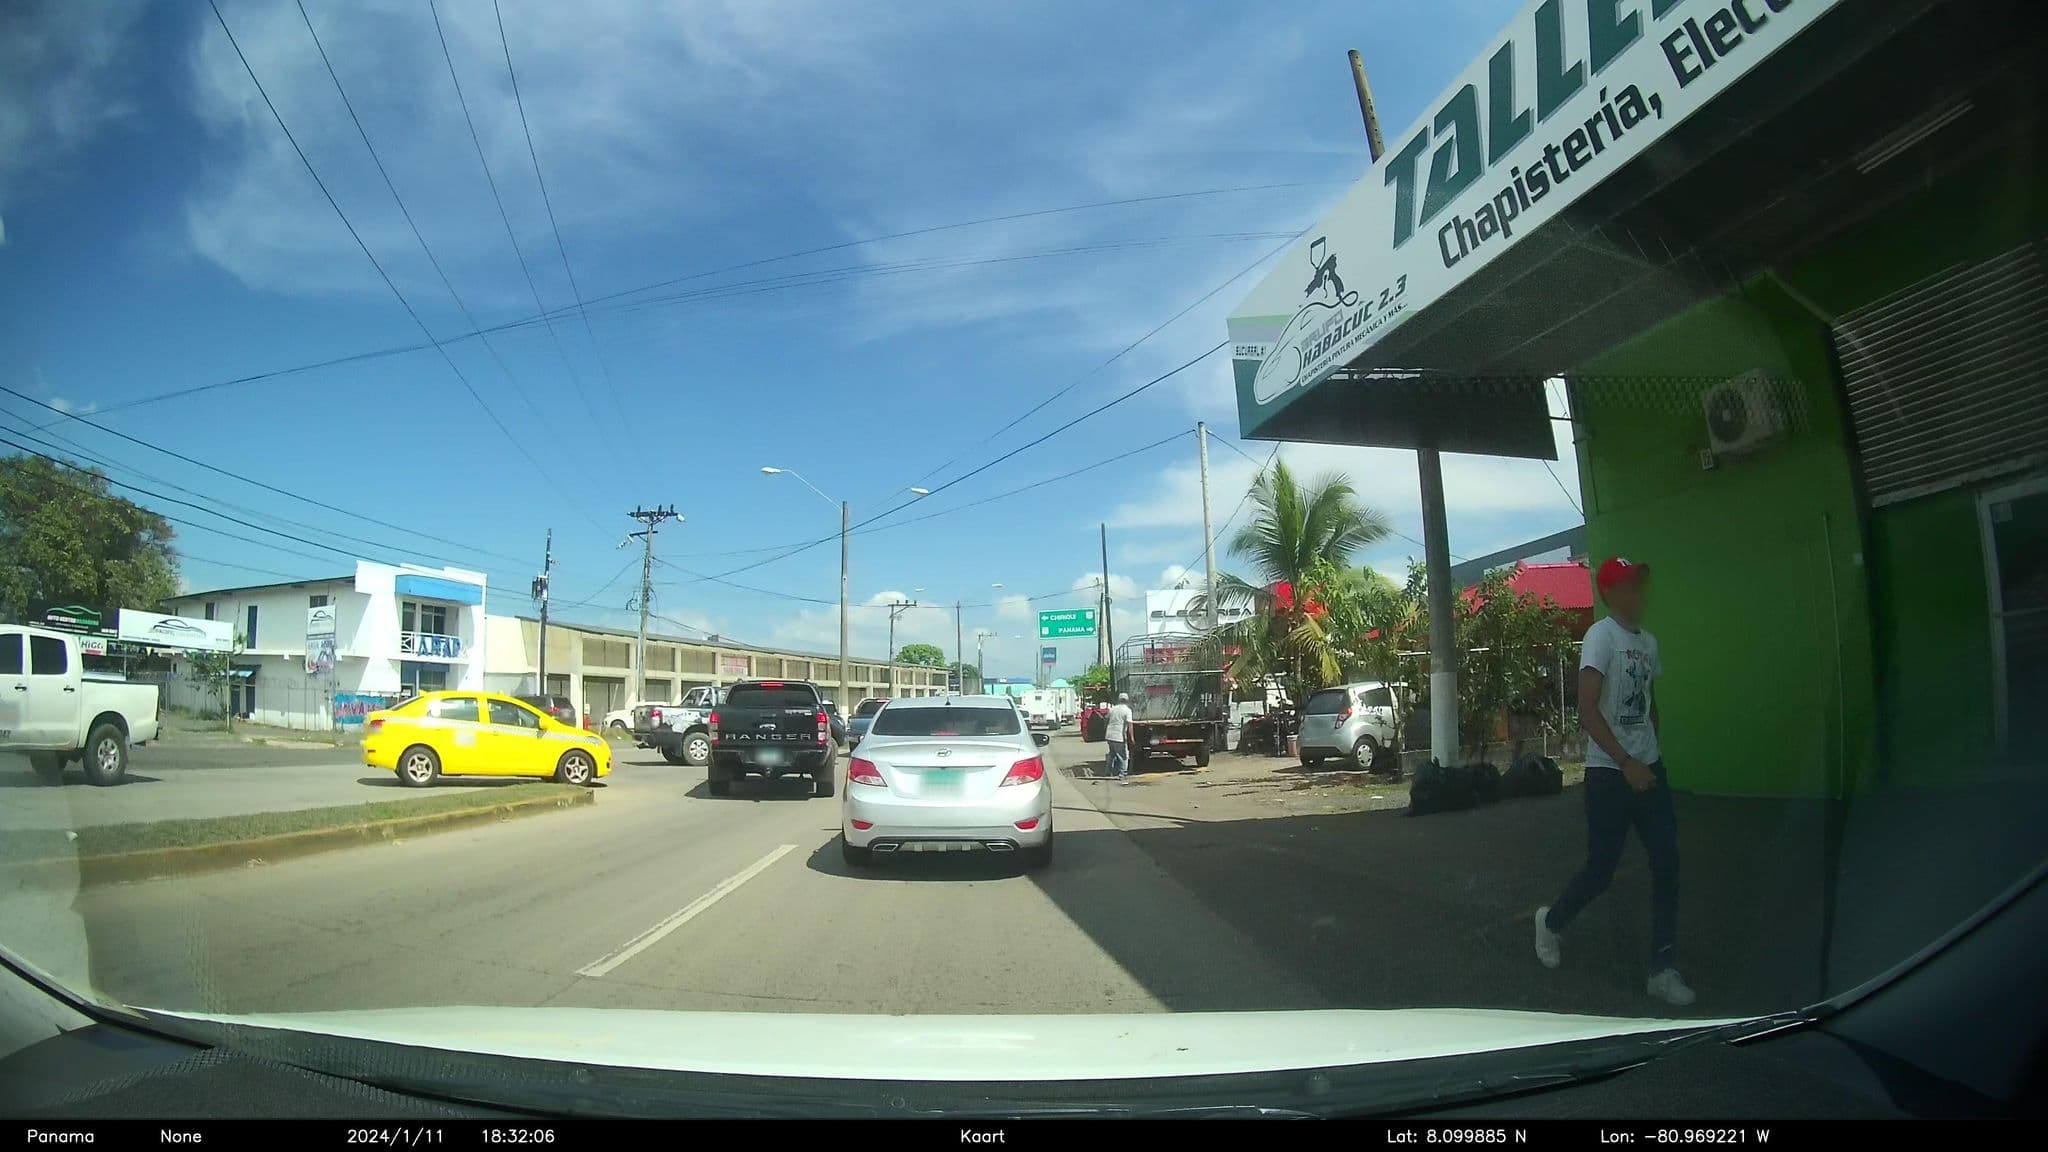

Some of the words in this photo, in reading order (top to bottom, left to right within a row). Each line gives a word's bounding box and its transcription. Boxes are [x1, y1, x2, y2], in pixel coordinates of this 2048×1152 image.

[1384, 0, 1685, 250] TALLE
[1438, 82, 1663, 269] Chapistería,
[1378, 274, 1407, 311] 2.3
